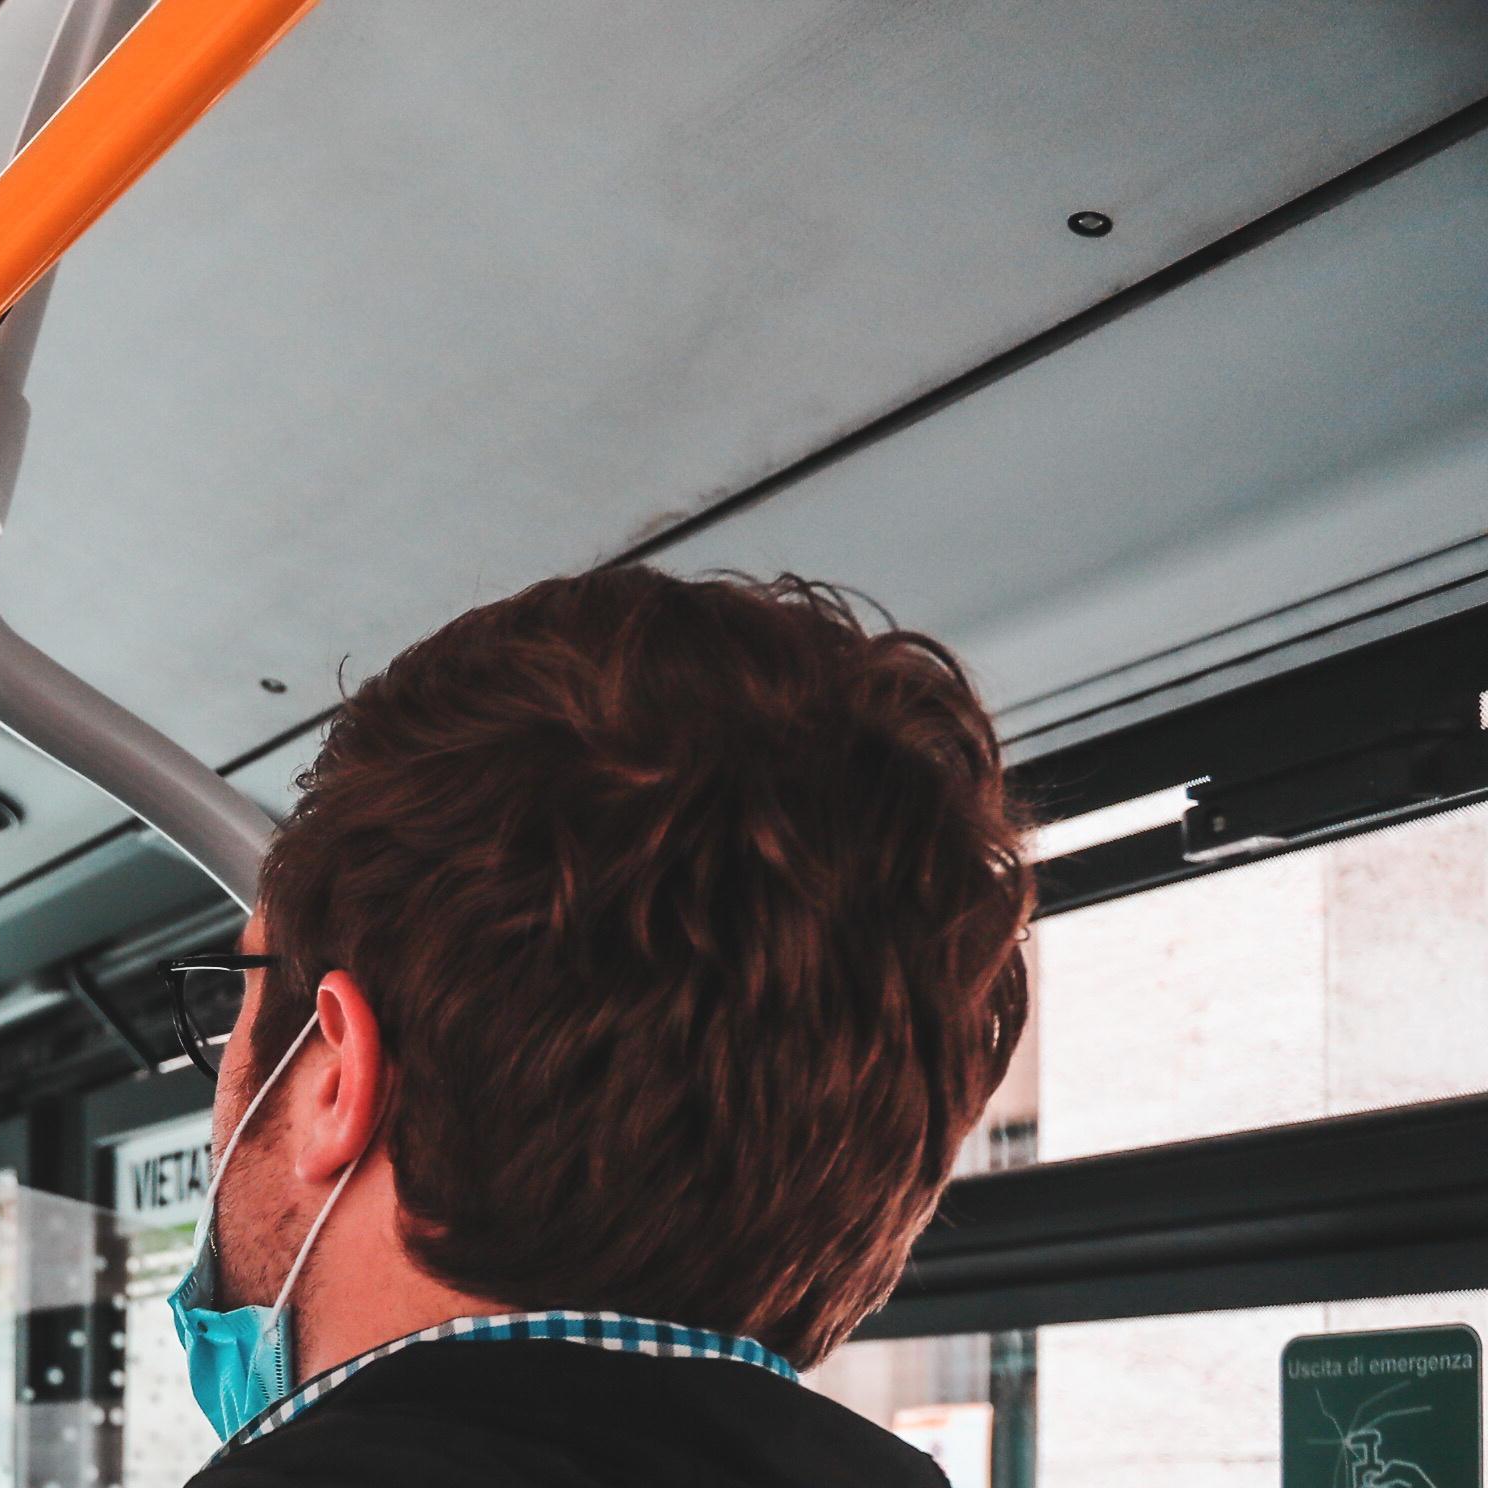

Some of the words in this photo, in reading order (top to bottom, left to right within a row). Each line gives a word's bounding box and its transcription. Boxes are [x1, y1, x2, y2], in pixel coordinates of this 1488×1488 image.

[134, 1143, 211, 1211] VIETA
[1288, 1358, 1342, 1379] Uscita
[1348, 1355, 1364, 1375] di
[1369, 1353, 1473, 1377] emergenza
